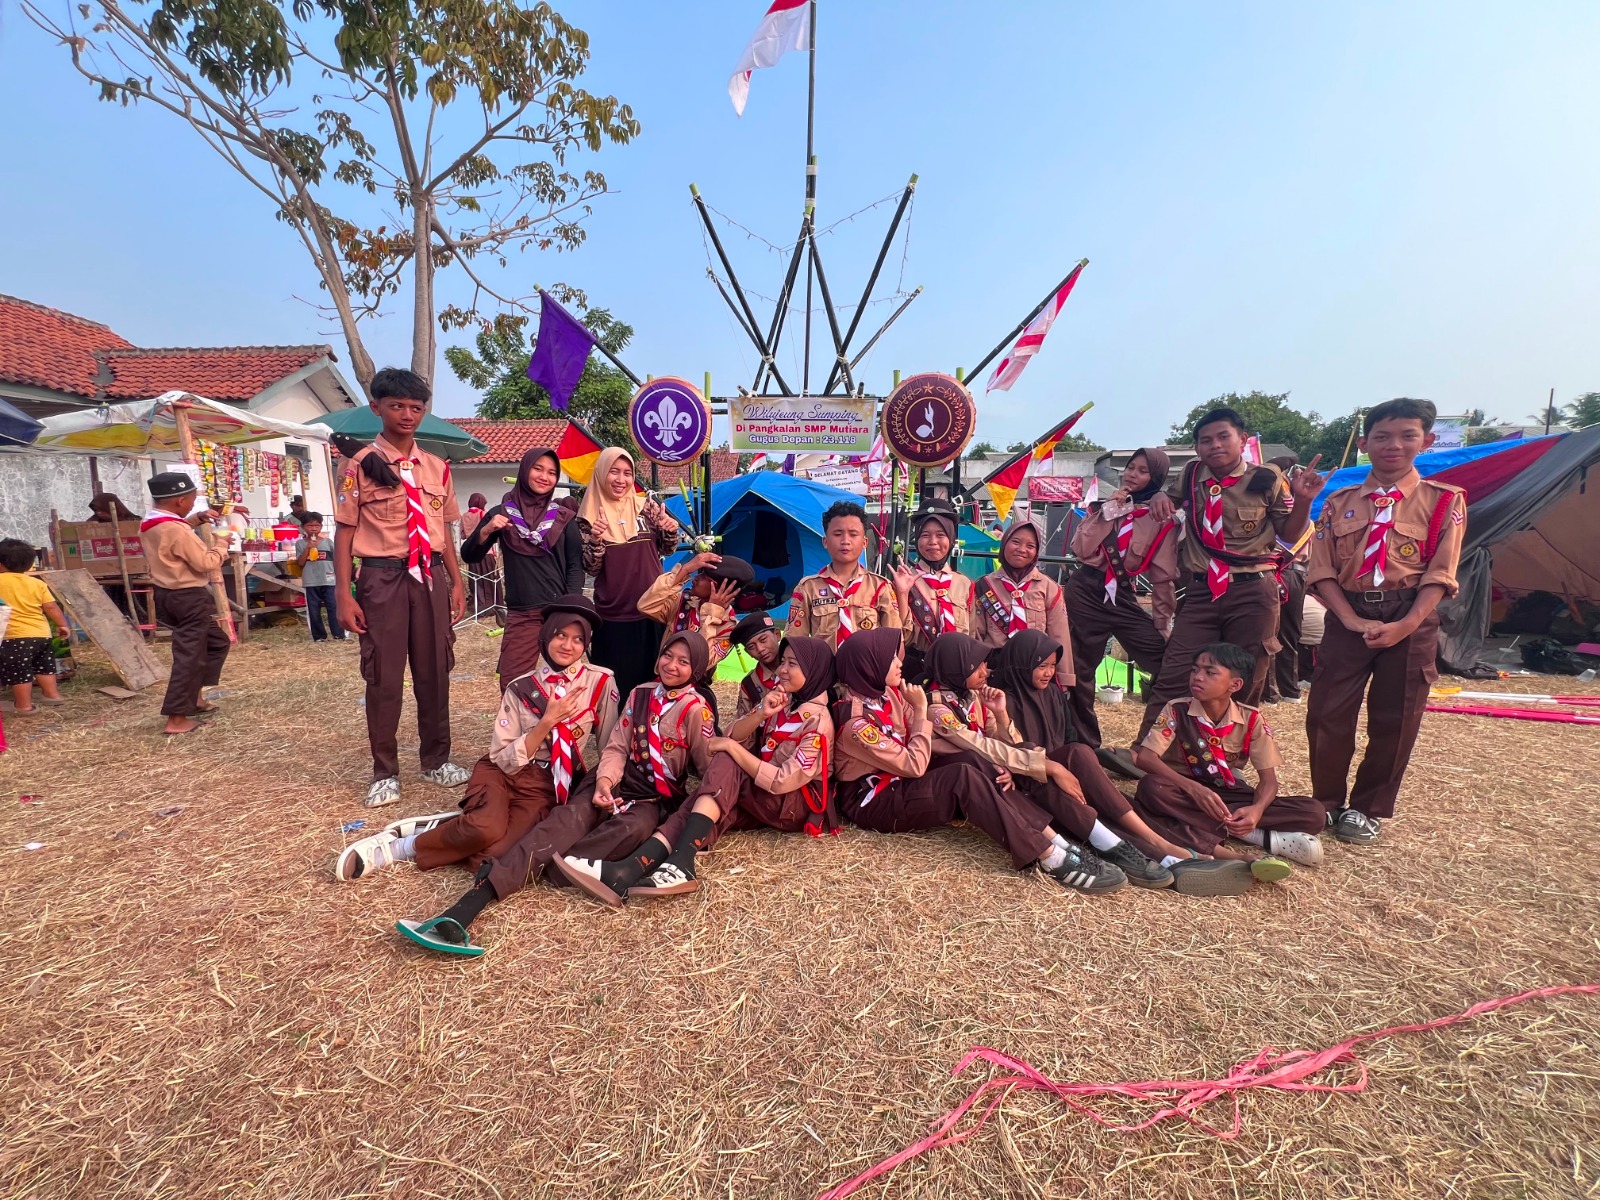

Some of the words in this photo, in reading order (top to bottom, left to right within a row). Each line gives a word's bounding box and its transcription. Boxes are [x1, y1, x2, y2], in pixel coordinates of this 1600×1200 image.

[743, 403, 803, 423] Wilujeung
[808, 403, 859, 425] Sumping
[736, 424, 746, 433] Di
[749, 424, 801, 434] Pangkalan
[804, 425, 826, 433] SMP
[829, 425, 869, 434] Mutiara
[748, 434, 779, 445] Gugus
[782, 435, 813, 445] Depan
[822, 435, 857, 444] 23.118
